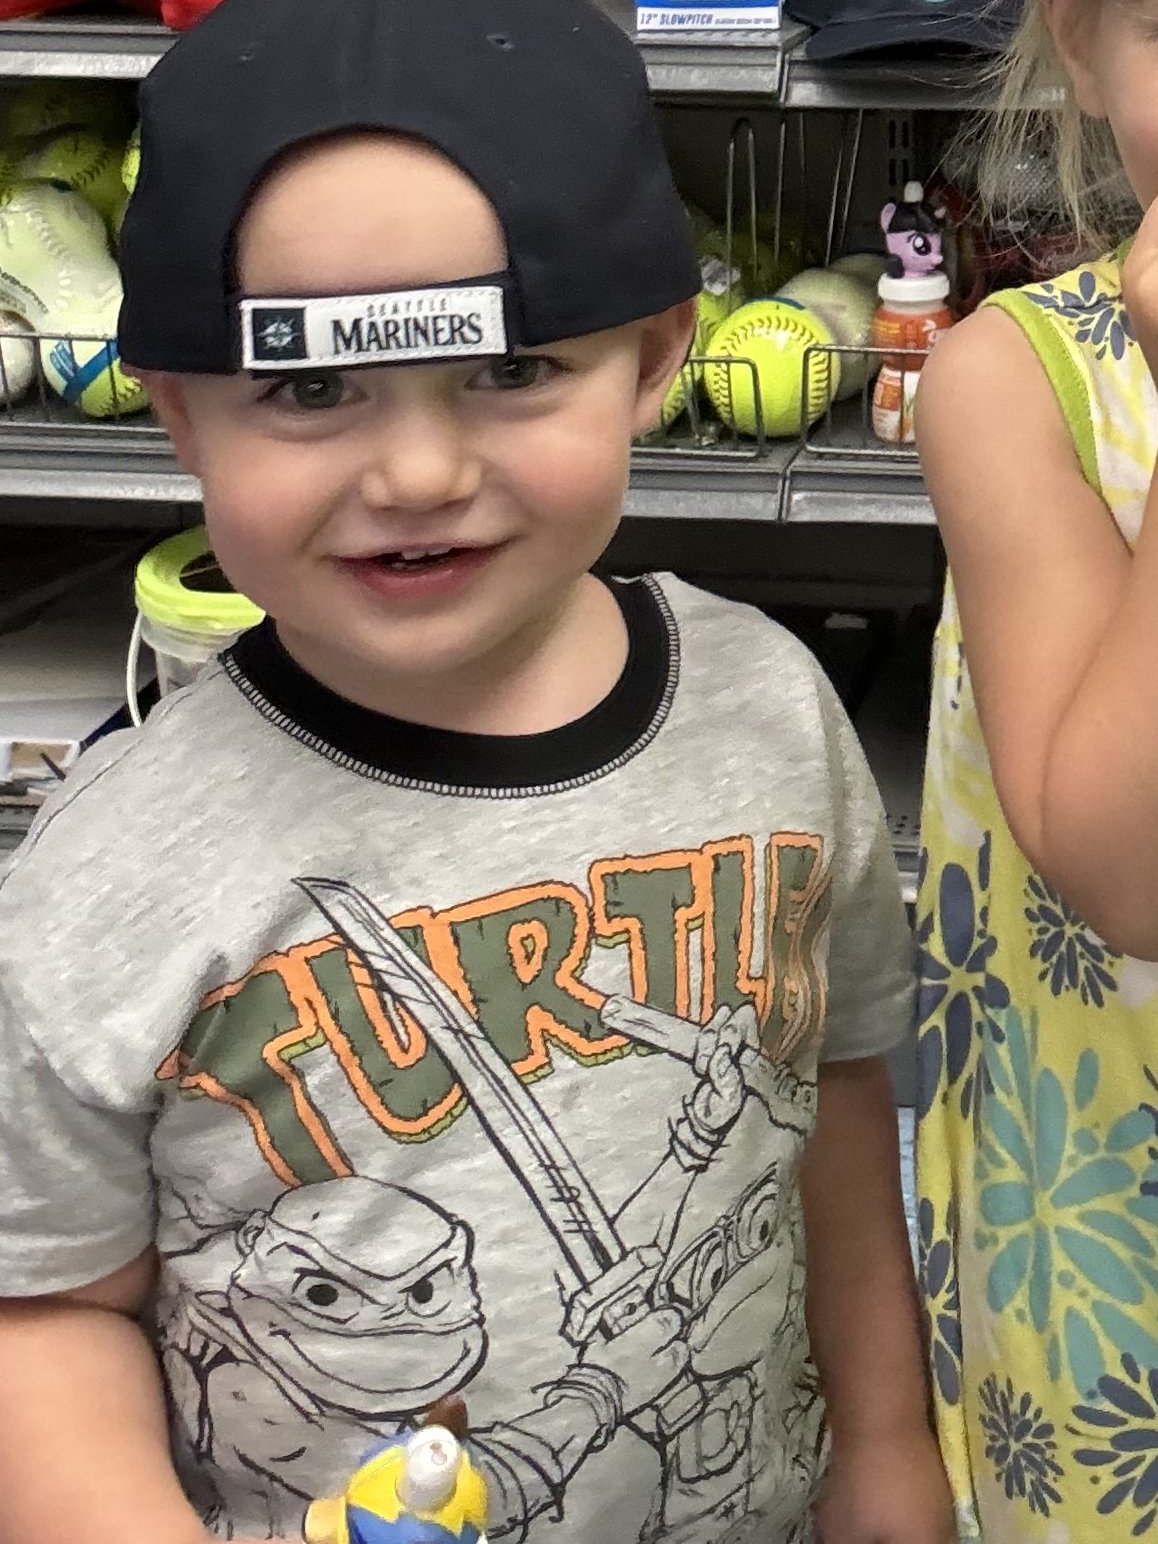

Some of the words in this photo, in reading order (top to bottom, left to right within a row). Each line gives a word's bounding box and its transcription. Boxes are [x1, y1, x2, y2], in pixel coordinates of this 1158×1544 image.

[659, 13, 714, 25] SLOWPITCH
[366, 297, 448, 319] SEATTLE
[330, 312, 483, 356] MARINERS
